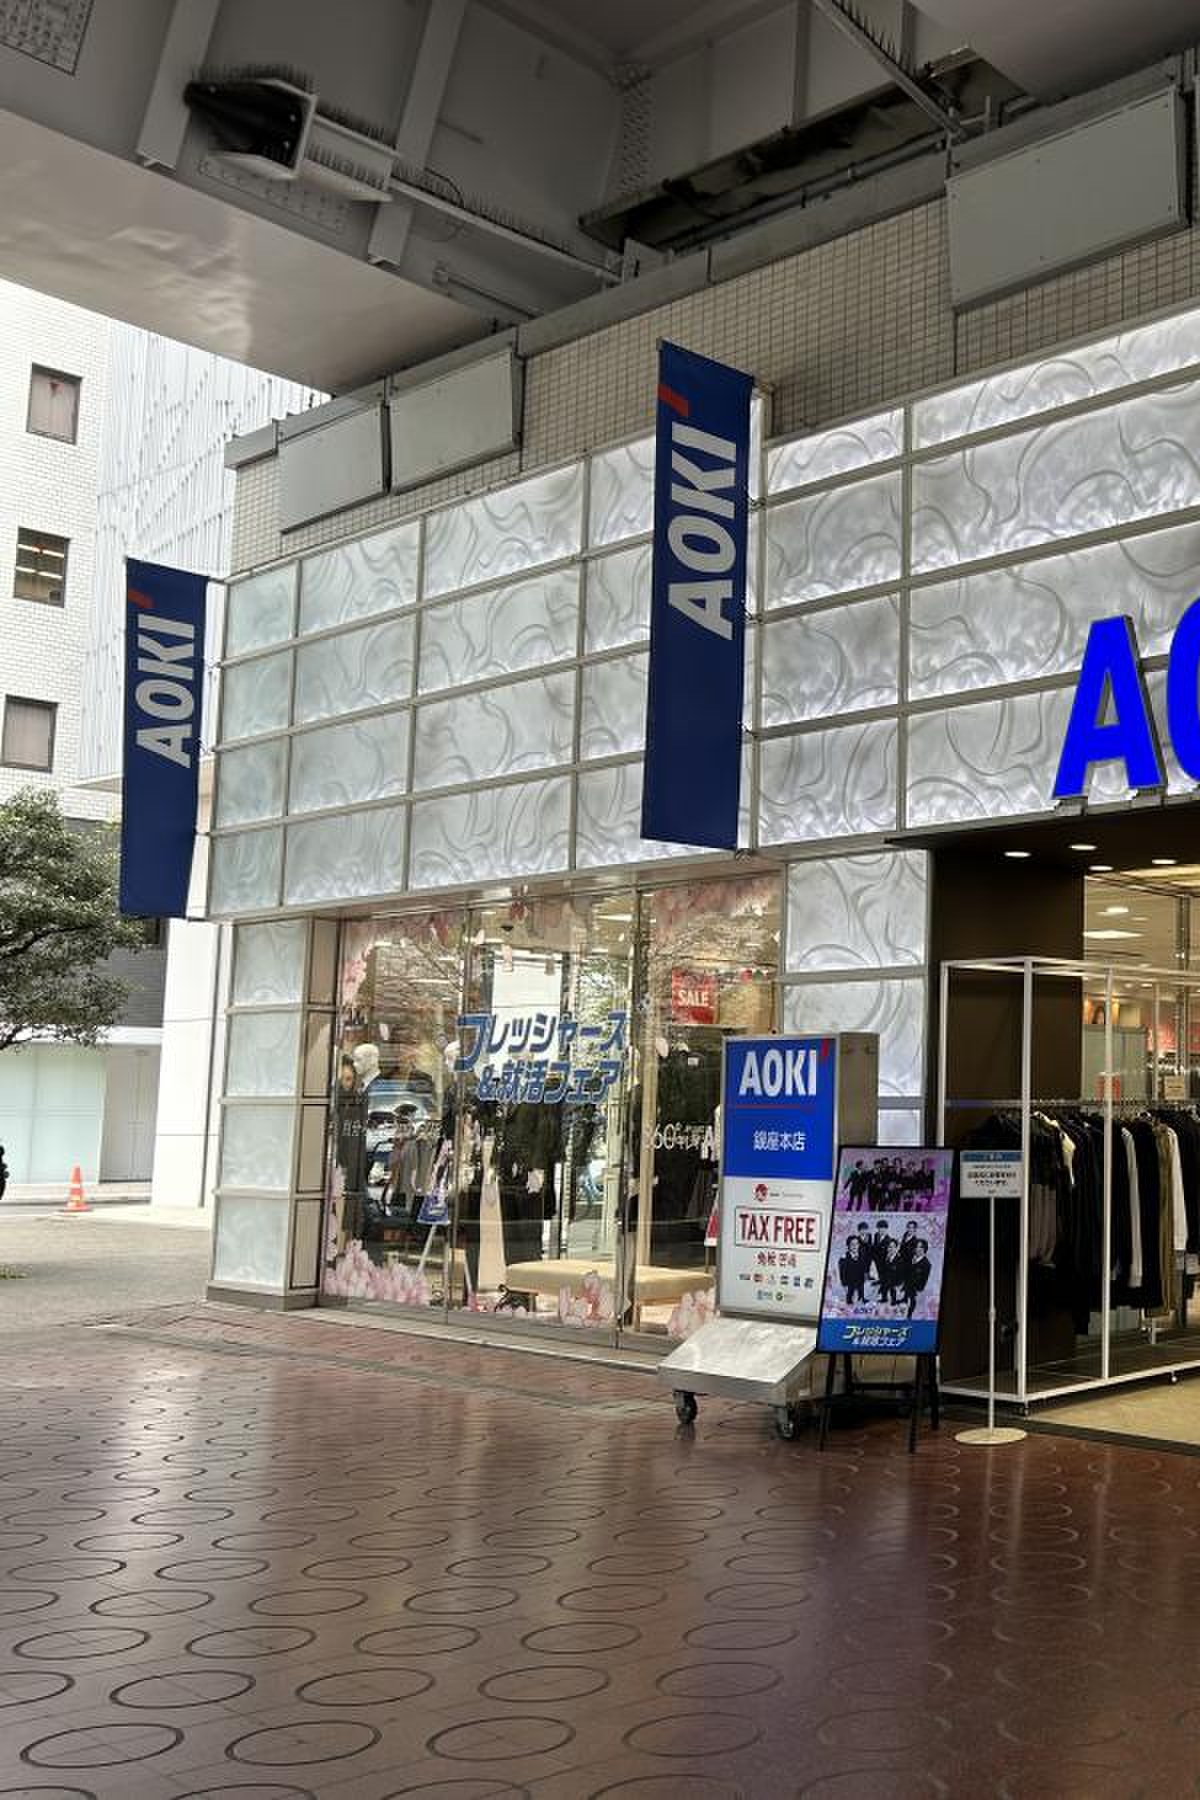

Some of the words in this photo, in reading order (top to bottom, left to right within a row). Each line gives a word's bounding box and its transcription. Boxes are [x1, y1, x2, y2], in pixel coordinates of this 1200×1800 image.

[668, 421, 737, 640] AOKI
[135, 613, 195, 768] AOKI
[678, 989, 710, 1008] SALE
[738, 1048, 818, 1097] AOKI
[753, 1130, 806, 1151] 銀座本店
[739, 1213, 769, 1240] TAX
[773, 1215, 816, 1245] FREE
